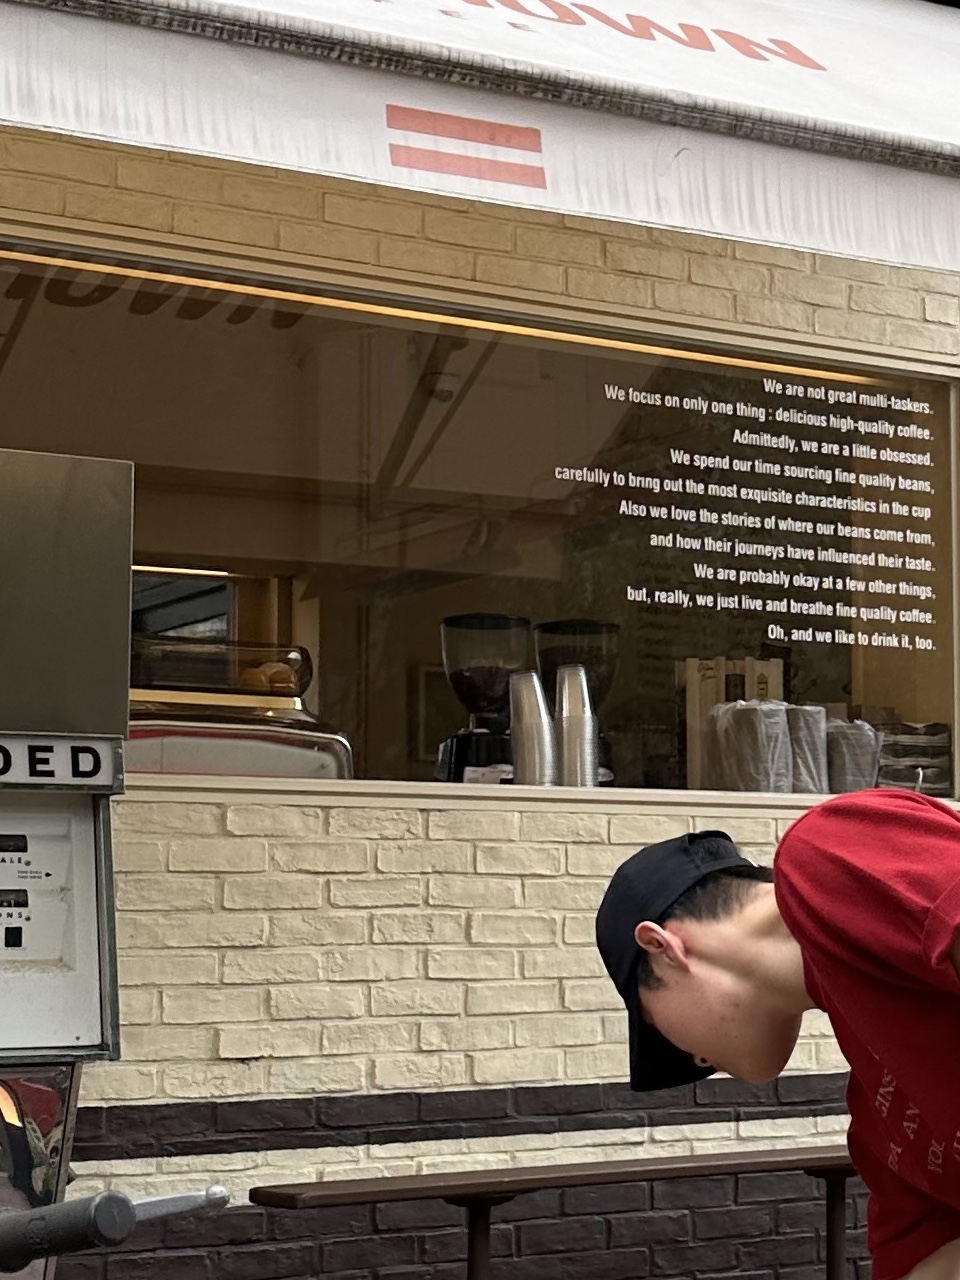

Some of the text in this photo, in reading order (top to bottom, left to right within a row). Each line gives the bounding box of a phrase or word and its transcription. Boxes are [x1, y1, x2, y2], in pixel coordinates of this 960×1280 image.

[603, 384, 626, 401] We
[627, 388, 662, 405] focus
[664, 396, 681, 407] on
[682, 397, 709, 414] only
[711, 402, 734, 415] one
[735, 402, 767, 422] thing
[774, 408, 828, 427] delicious
[829, 414, 895, 438] high-quality
[896, 424, 935, 440] coffee.
[762, 378, 935, 414] We are not great multi-taskers.
[732, 429, 935, 466] Admittedly, we are a little obsessed.
[669, 449, 935, 494] We spend our time sourcing fine quality beans,
[554, 467, 932, 520] carefully to bring out the most exquisite characteristics in the cup
[618, 500, 936, 546] Also we love the stories of where our beans come from,
[649, 533, 936, 571] and how their journeys have influenced their taste.
[693, 563, 937, 599] We are probably okay at a few other things,
[626, 586, 937, 623] but, really, we just live and breathe fine quality coffee.
[767, 624, 937, 650] Oh, and we like to drink it, too.
